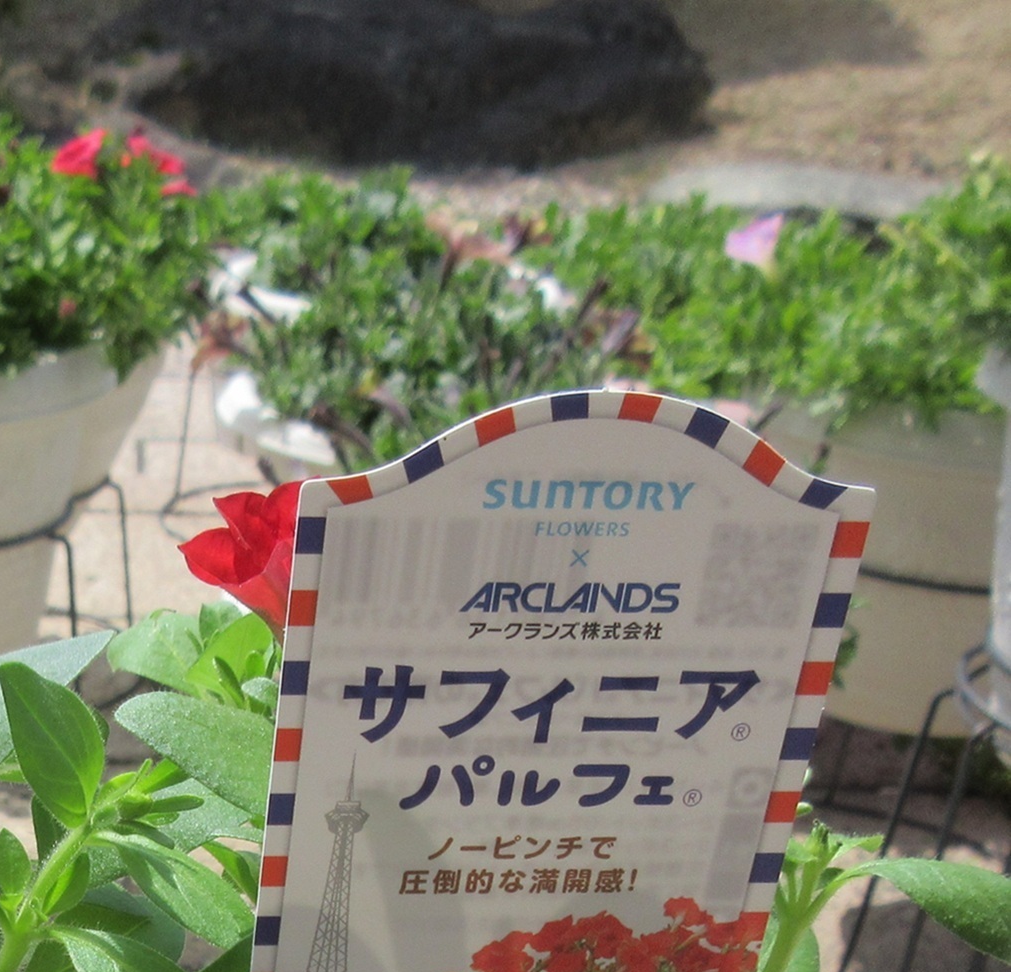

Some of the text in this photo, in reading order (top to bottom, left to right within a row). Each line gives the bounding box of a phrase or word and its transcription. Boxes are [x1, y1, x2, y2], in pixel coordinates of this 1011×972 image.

[535, 521, 630, 538] FLOWERS
[459, 582, 681, 614] ARCLANDS
[467, 621, 663, 641] アークランズ株式会社
[428, 836, 617, 861] ノーピンチで
